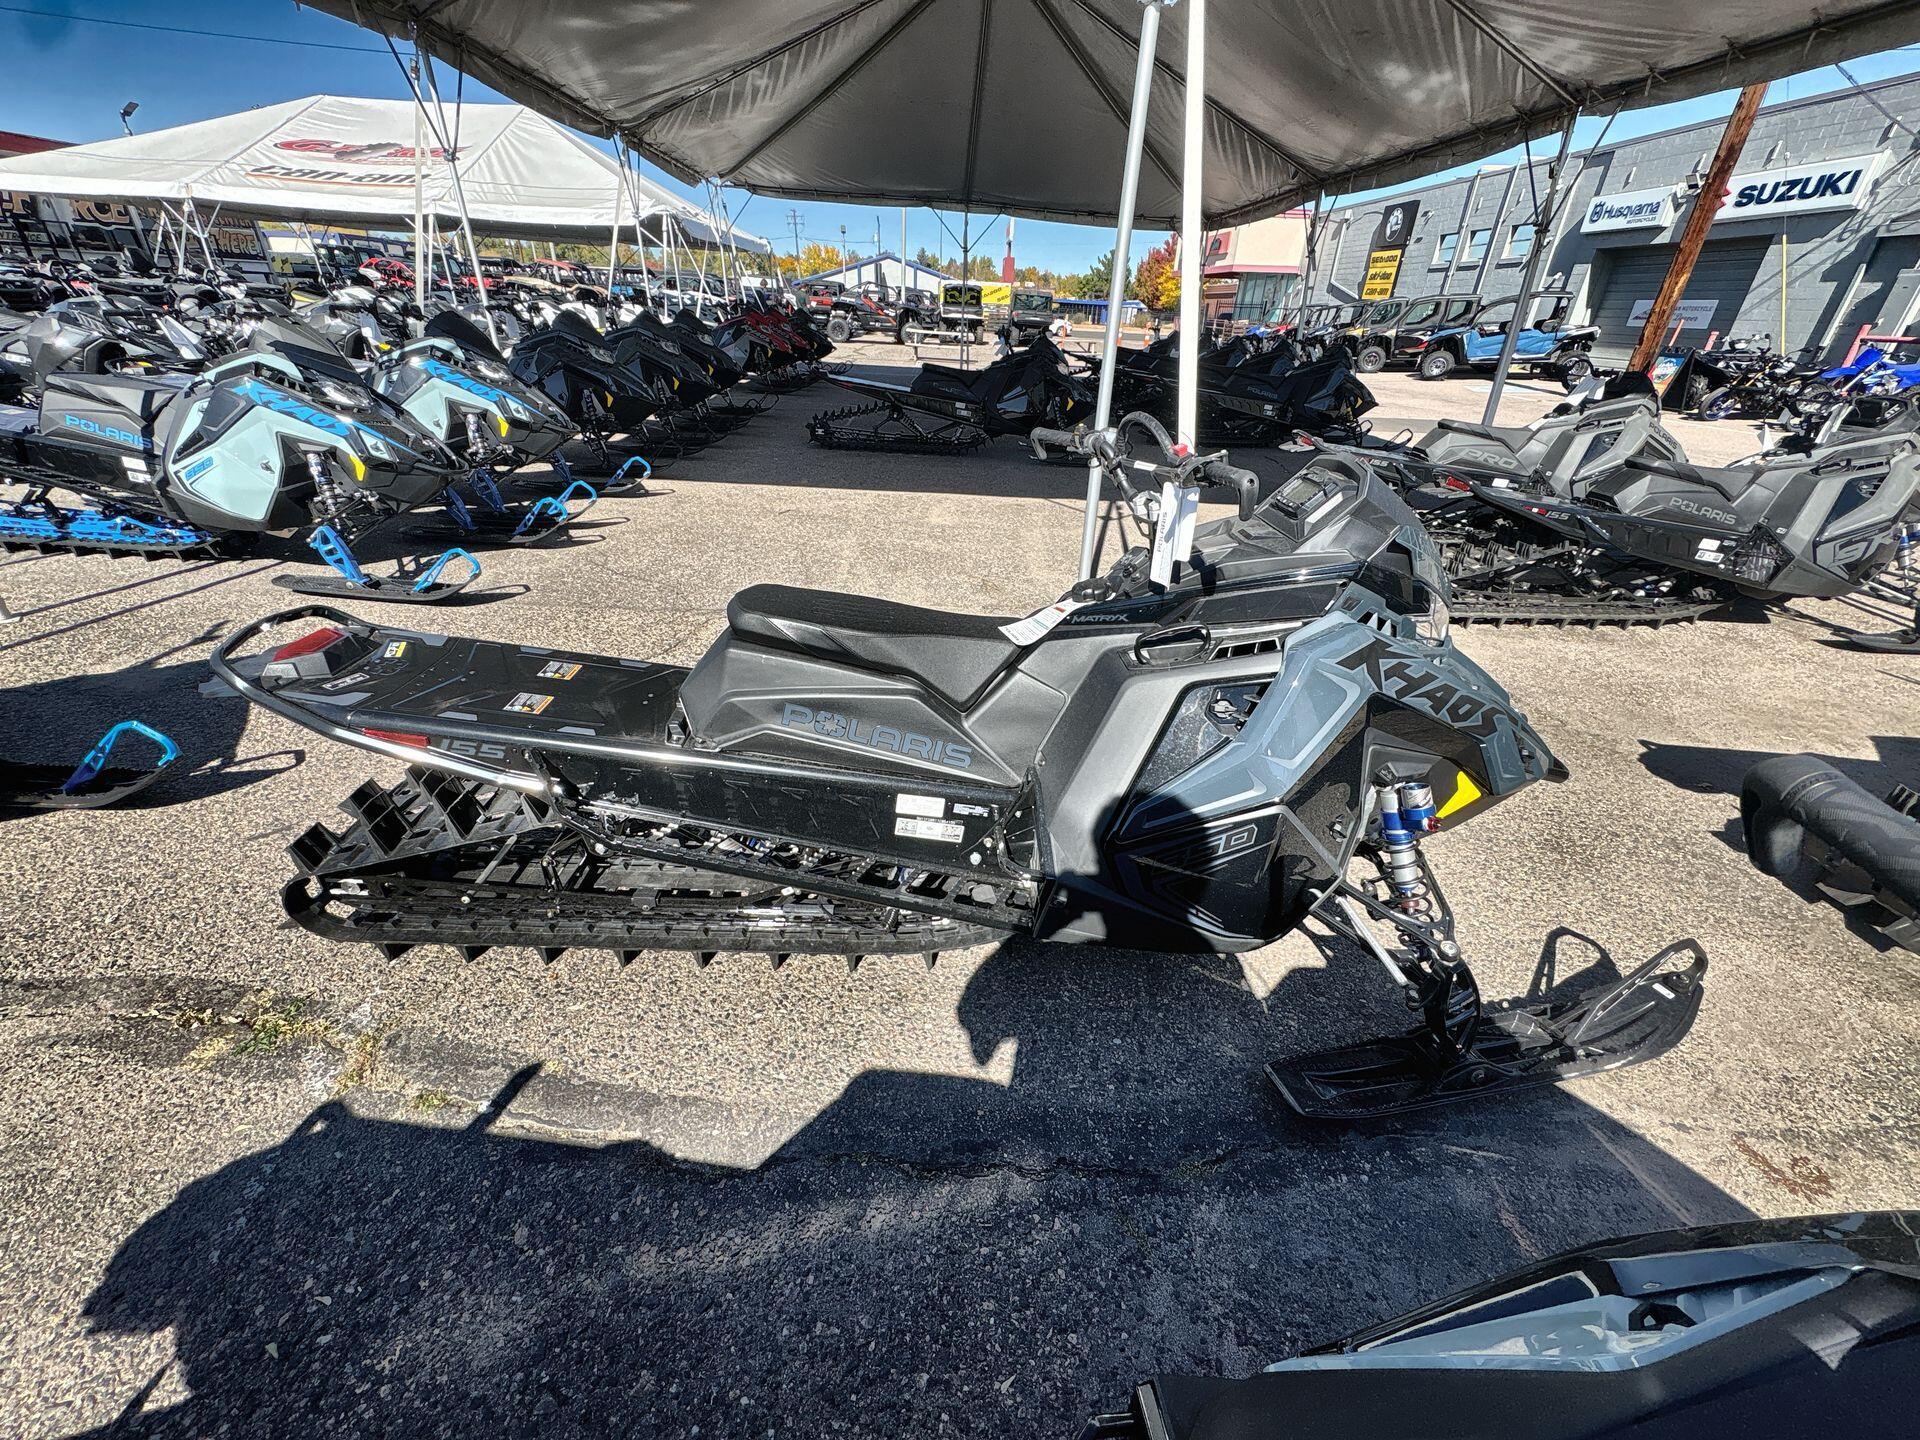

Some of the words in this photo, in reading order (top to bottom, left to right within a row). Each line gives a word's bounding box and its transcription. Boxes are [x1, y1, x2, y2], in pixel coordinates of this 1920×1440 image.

[1734, 168, 1864, 208] SUZUKI
[1602, 201, 1661, 219] Husqvarna
[232, 380, 350, 436] KHAOS
[65, 414, 152, 449] POLARIS
[1649, 421, 1678, 450] POLARIS
[1459, 448, 1519, 470] PRO
[1669, 497, 1737, 525] POLARIS
[1071, 613, 1129, 624] MATRYX
[1334, 636, 1507, 738] KHAOS
[440, 738, 506, 759] 155
[781, 703, 972, 768] POLARIS
